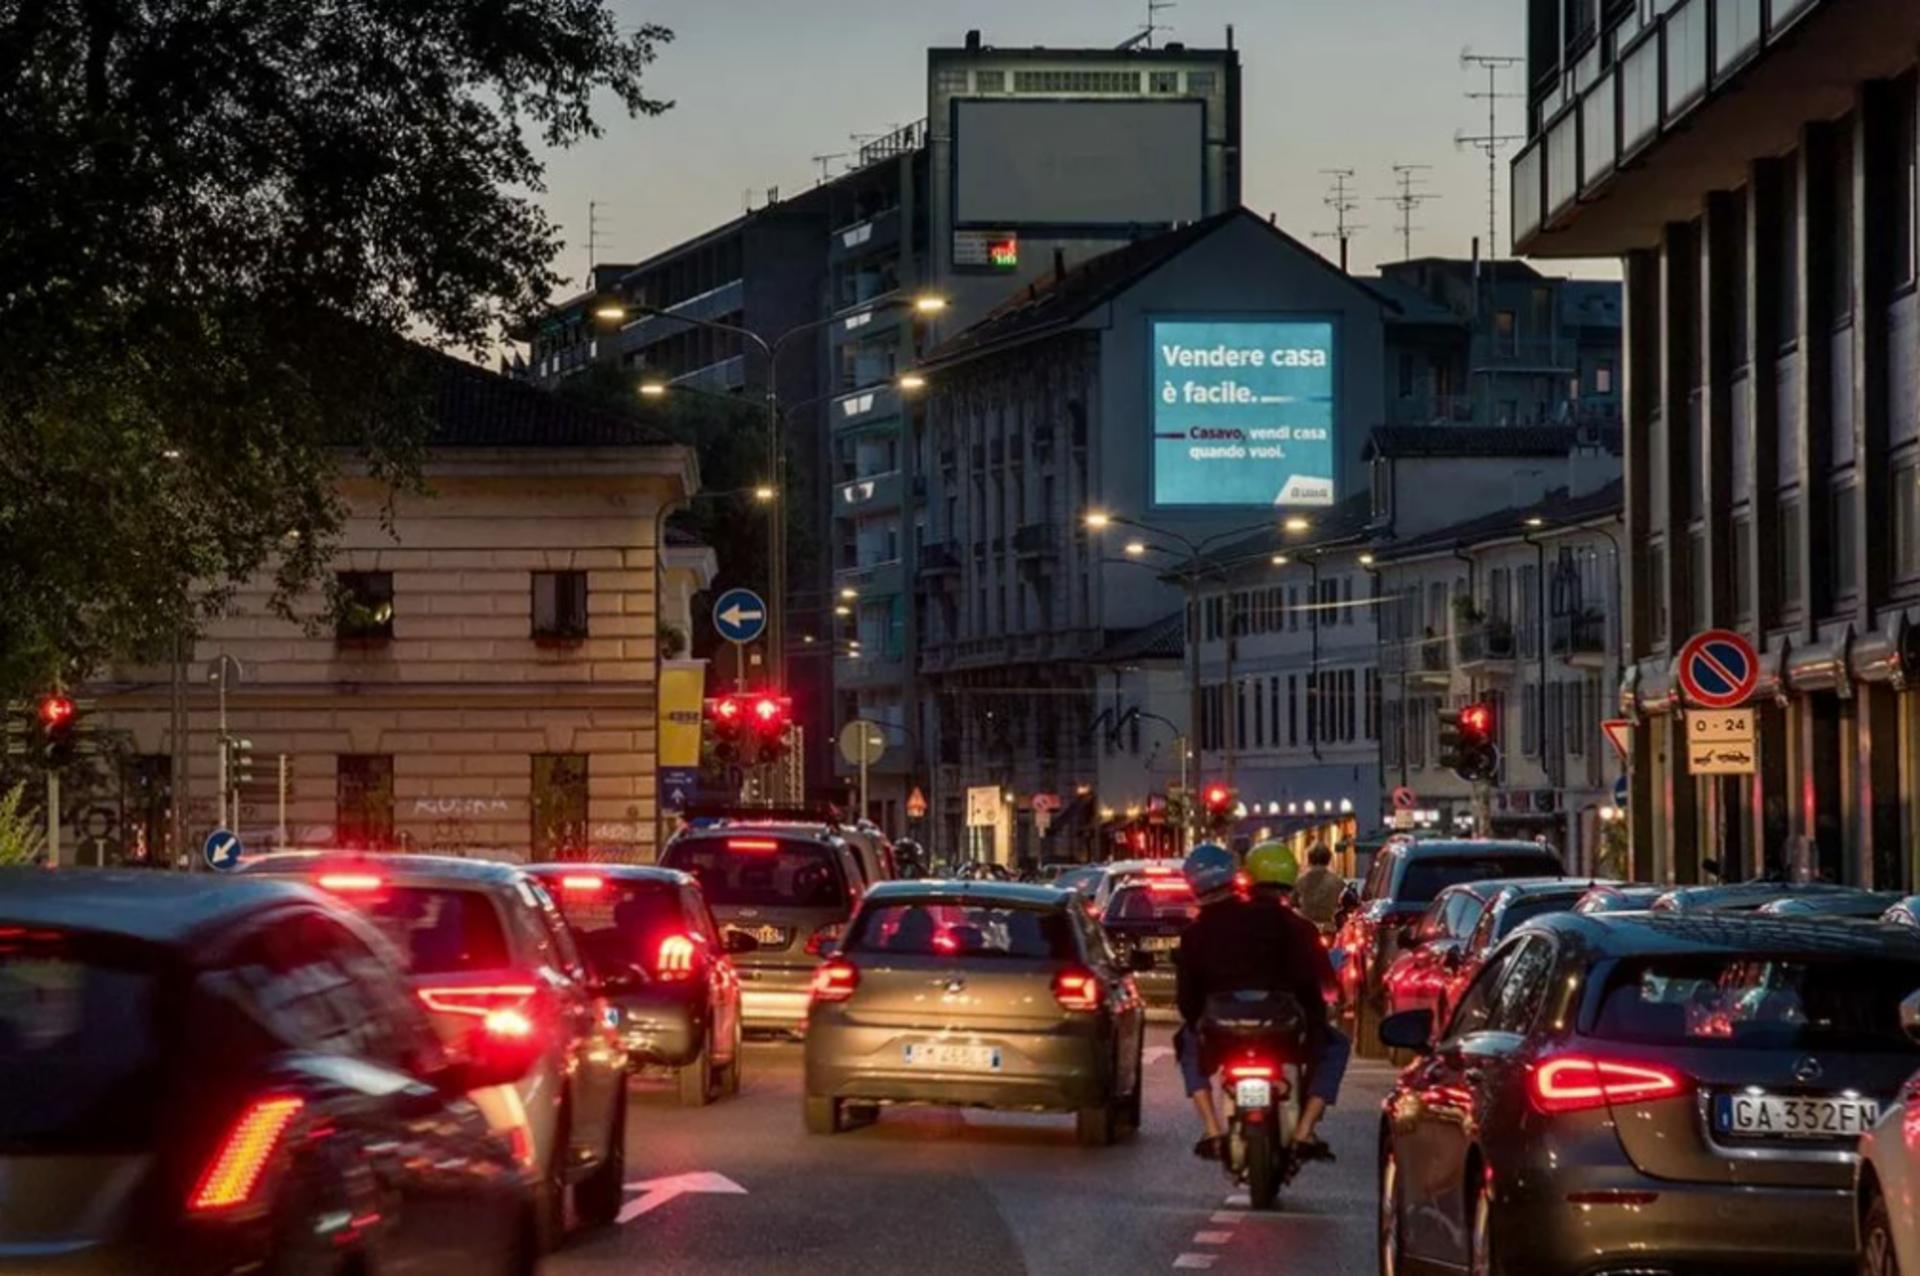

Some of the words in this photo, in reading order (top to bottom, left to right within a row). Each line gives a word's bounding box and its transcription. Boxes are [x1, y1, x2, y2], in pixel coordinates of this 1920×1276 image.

[1162, 345, 1264, 367] Vendere
[1271, 349, 1327, 367] casa
[1162, 381, 1177, 403] è
[1184, 381, 1257, 403] facile.
[1190, 426, 1246, 441] Casavo,
[1250, 427, 1290, 440] vendi
[1293, 428, 1326, 440] casa
[1189, 446, 1245, 460] quando
[1249, 445, 1286, 459] vuoi.
[1725, 719, 1745, 731] 24
